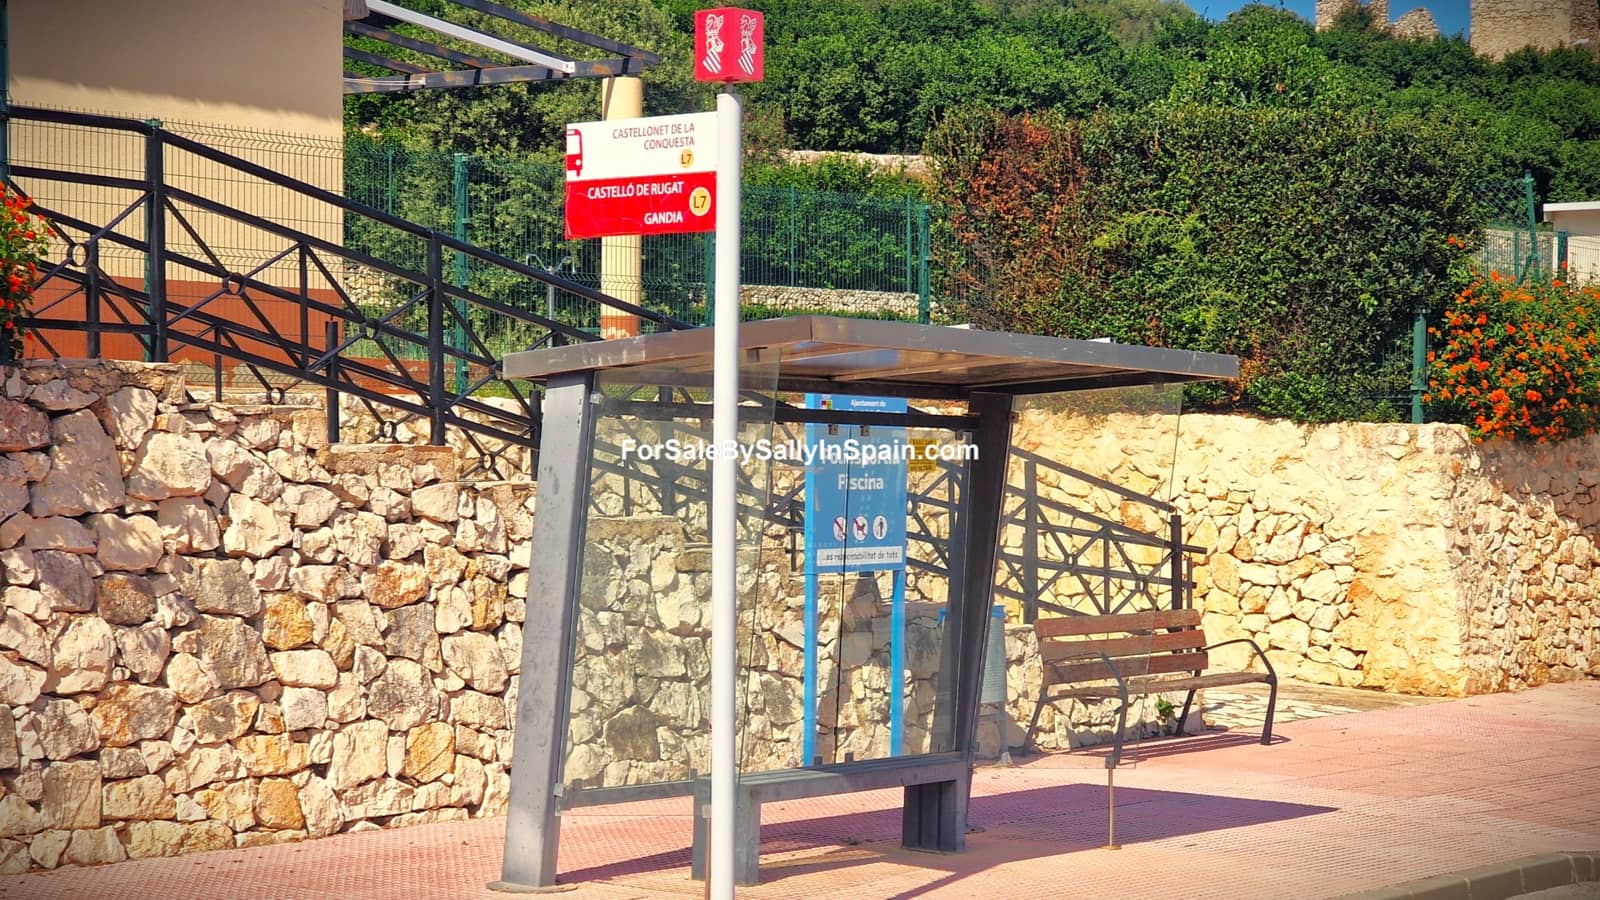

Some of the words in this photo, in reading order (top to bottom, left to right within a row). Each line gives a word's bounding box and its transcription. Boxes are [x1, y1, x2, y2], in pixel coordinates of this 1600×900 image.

[612, 125, 669, 139] CASTELLONET
[671, 124, 683, 134] DE
[684, 123, 695, 133] LA
[644, 137, 695, 150] CONQUESTA
[681, 154, 692, 165] L7
[587, 183, 634, 199] CASTELLÓ
[636, 184, 649, 196] DE
[651, 182, 684, 195] RUGAT
[693, 196, 707, 209] L7
[644, 211, 683, 225] GANDIA
[838, 473, 884, 490] Piscina
